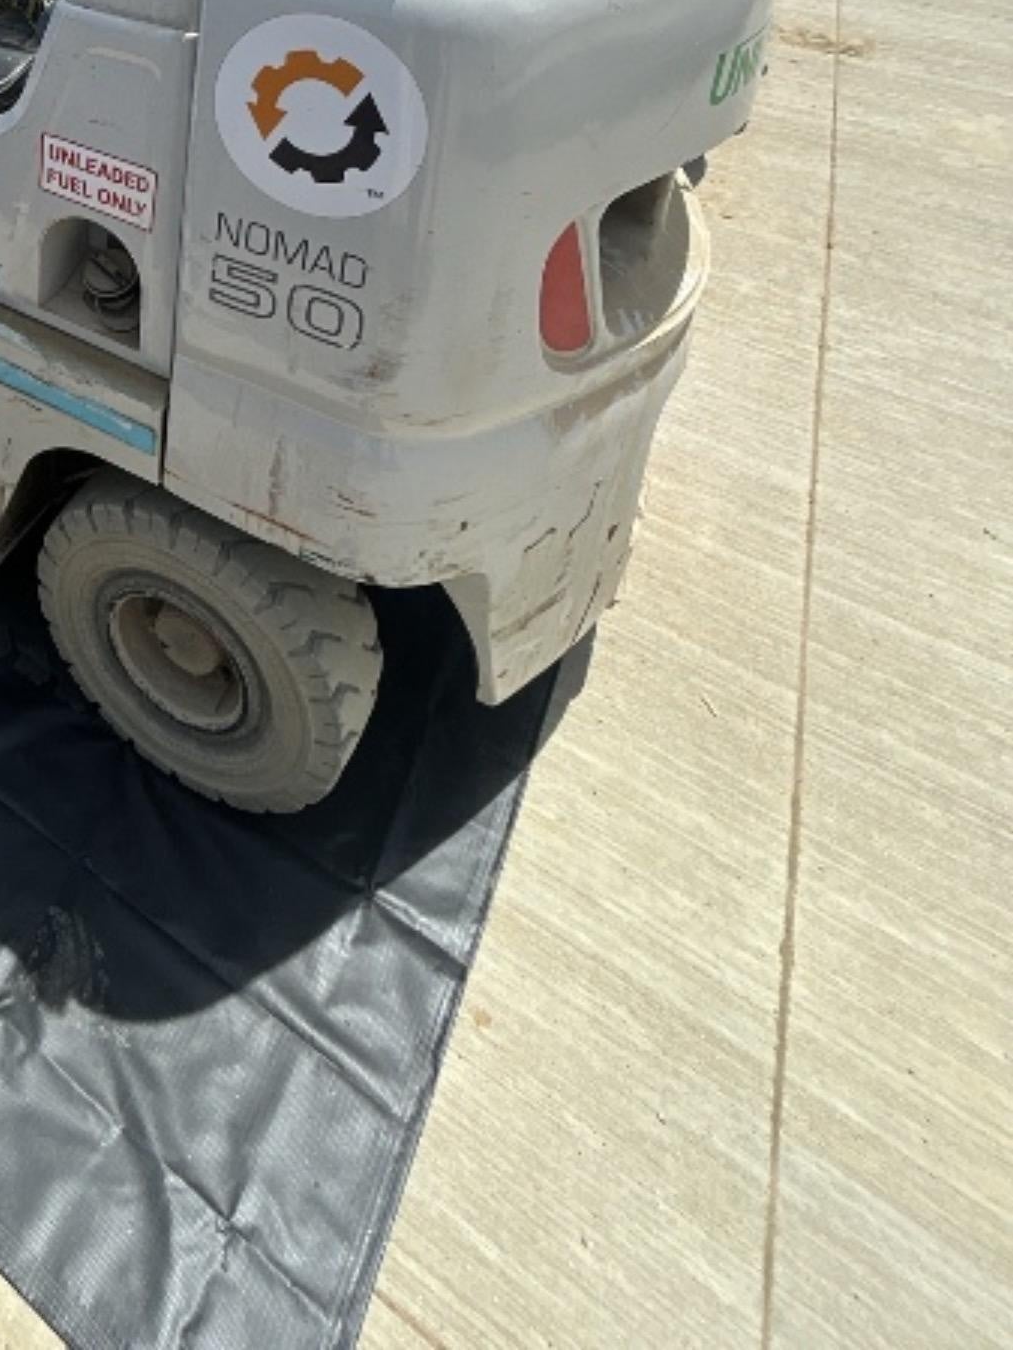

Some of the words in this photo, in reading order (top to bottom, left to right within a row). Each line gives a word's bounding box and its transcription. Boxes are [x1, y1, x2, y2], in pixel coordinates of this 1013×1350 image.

[46, 168, 93, 199] FUEL
[97, 188, 147, 217] ONLY
[48, 143, 150, 193] UNLEADED
[213, 211, 369, 289] NOMAD
[208, 252, 364, 351] 50
